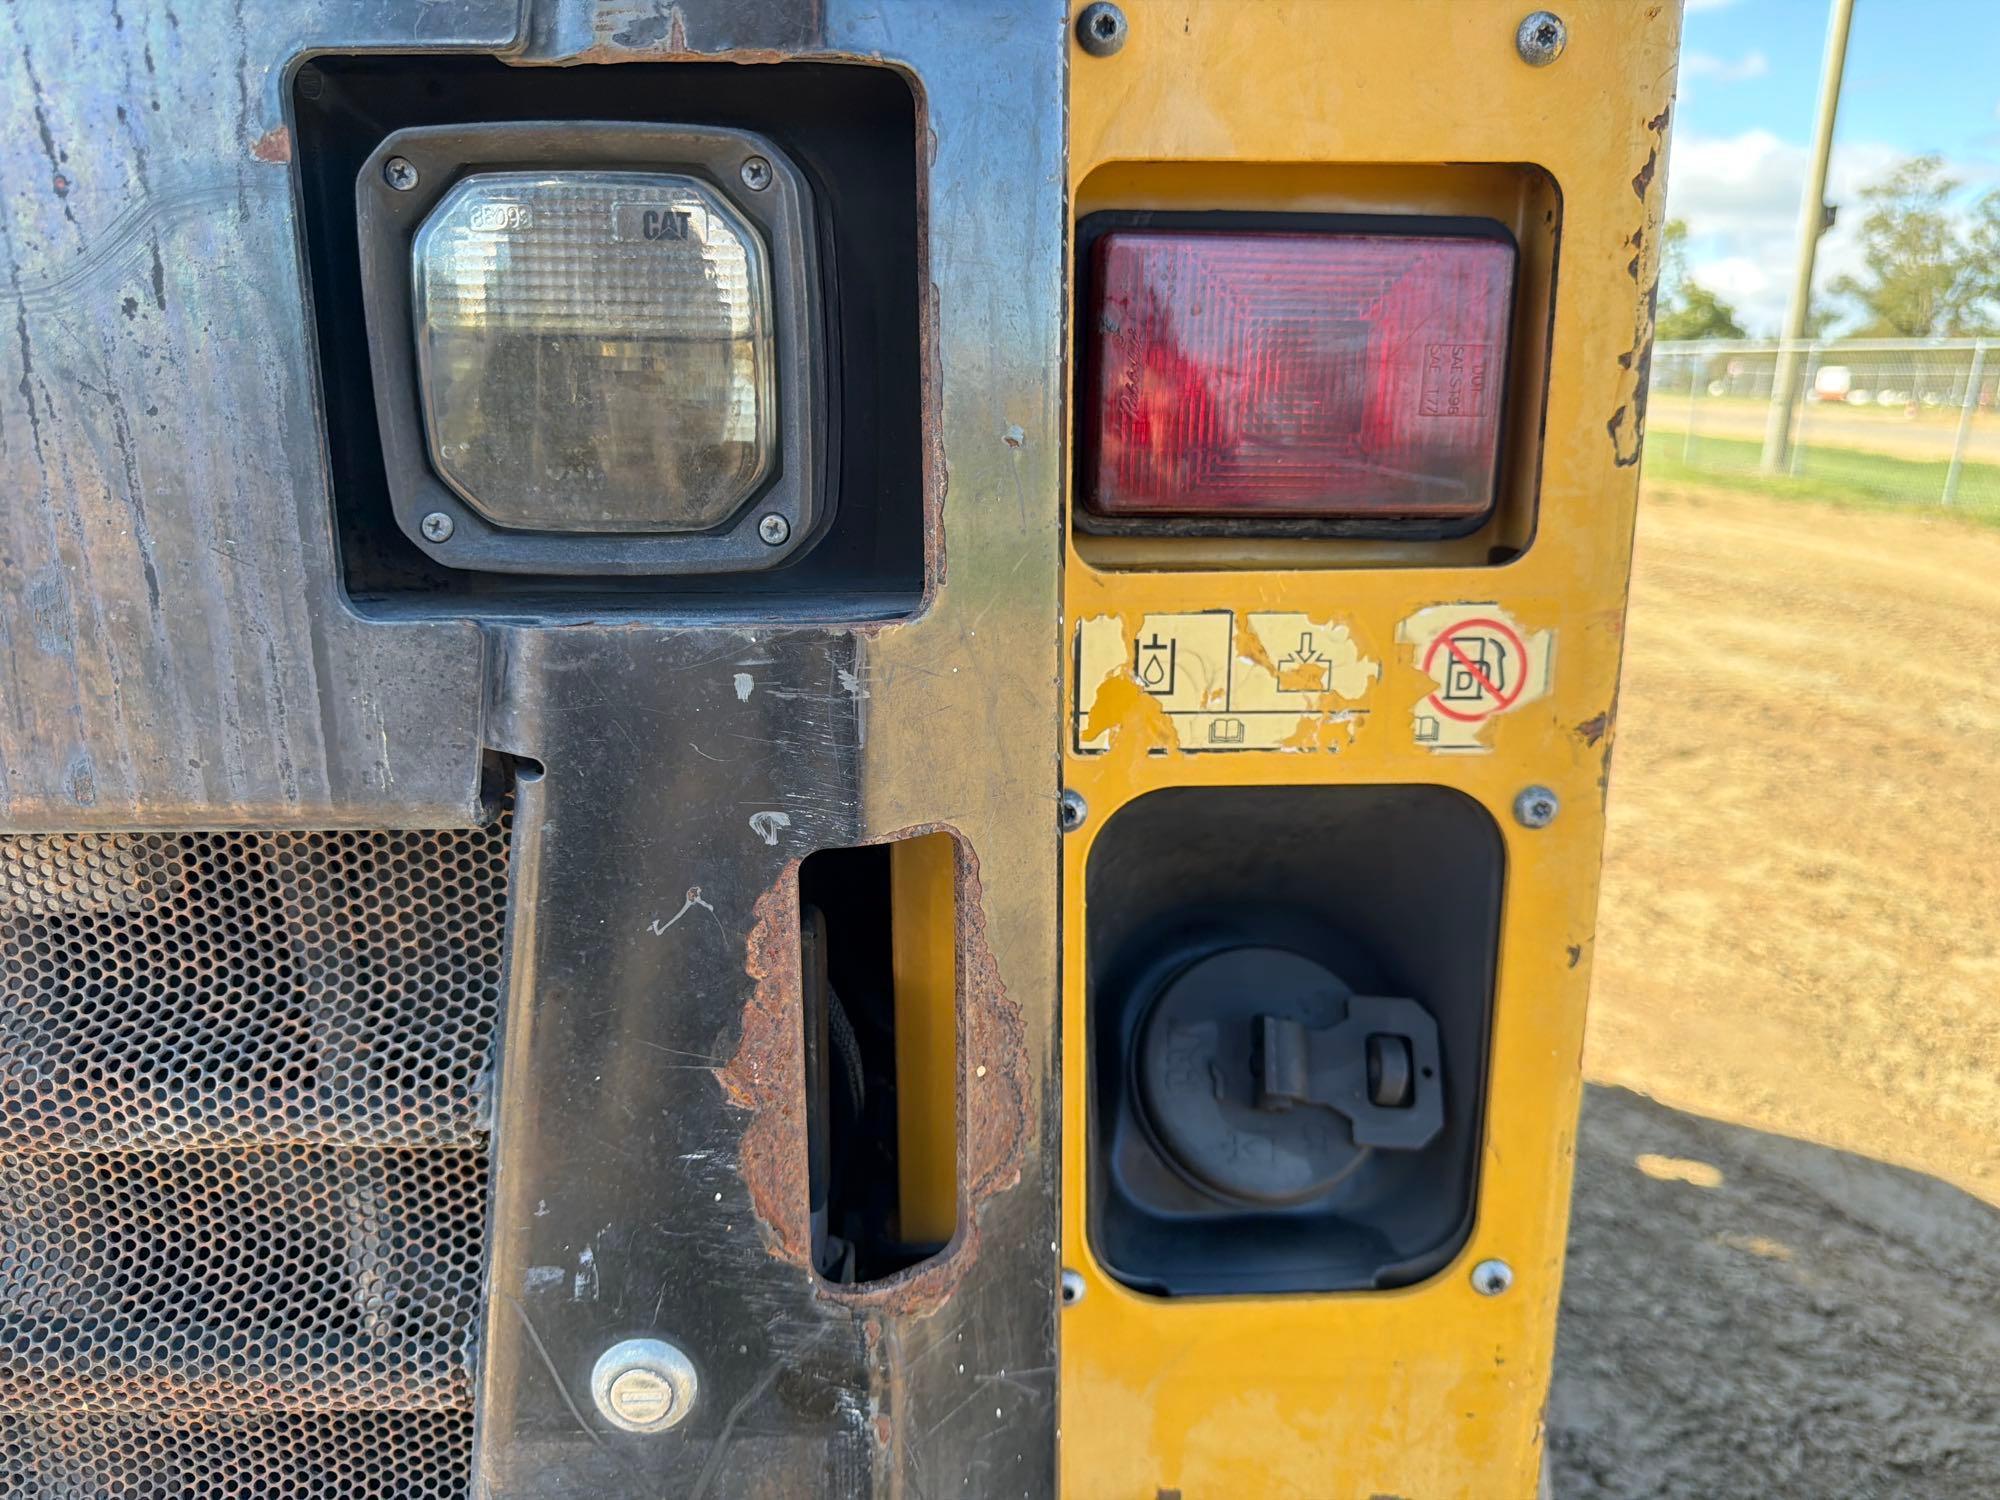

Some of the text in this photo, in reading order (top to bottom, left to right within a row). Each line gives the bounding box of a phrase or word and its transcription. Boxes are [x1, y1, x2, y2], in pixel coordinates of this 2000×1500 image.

[643, 210, 691, 240] CAT
[1451, 346, 1464, 374] SAE
[1455, 671, 1473, 691] D
